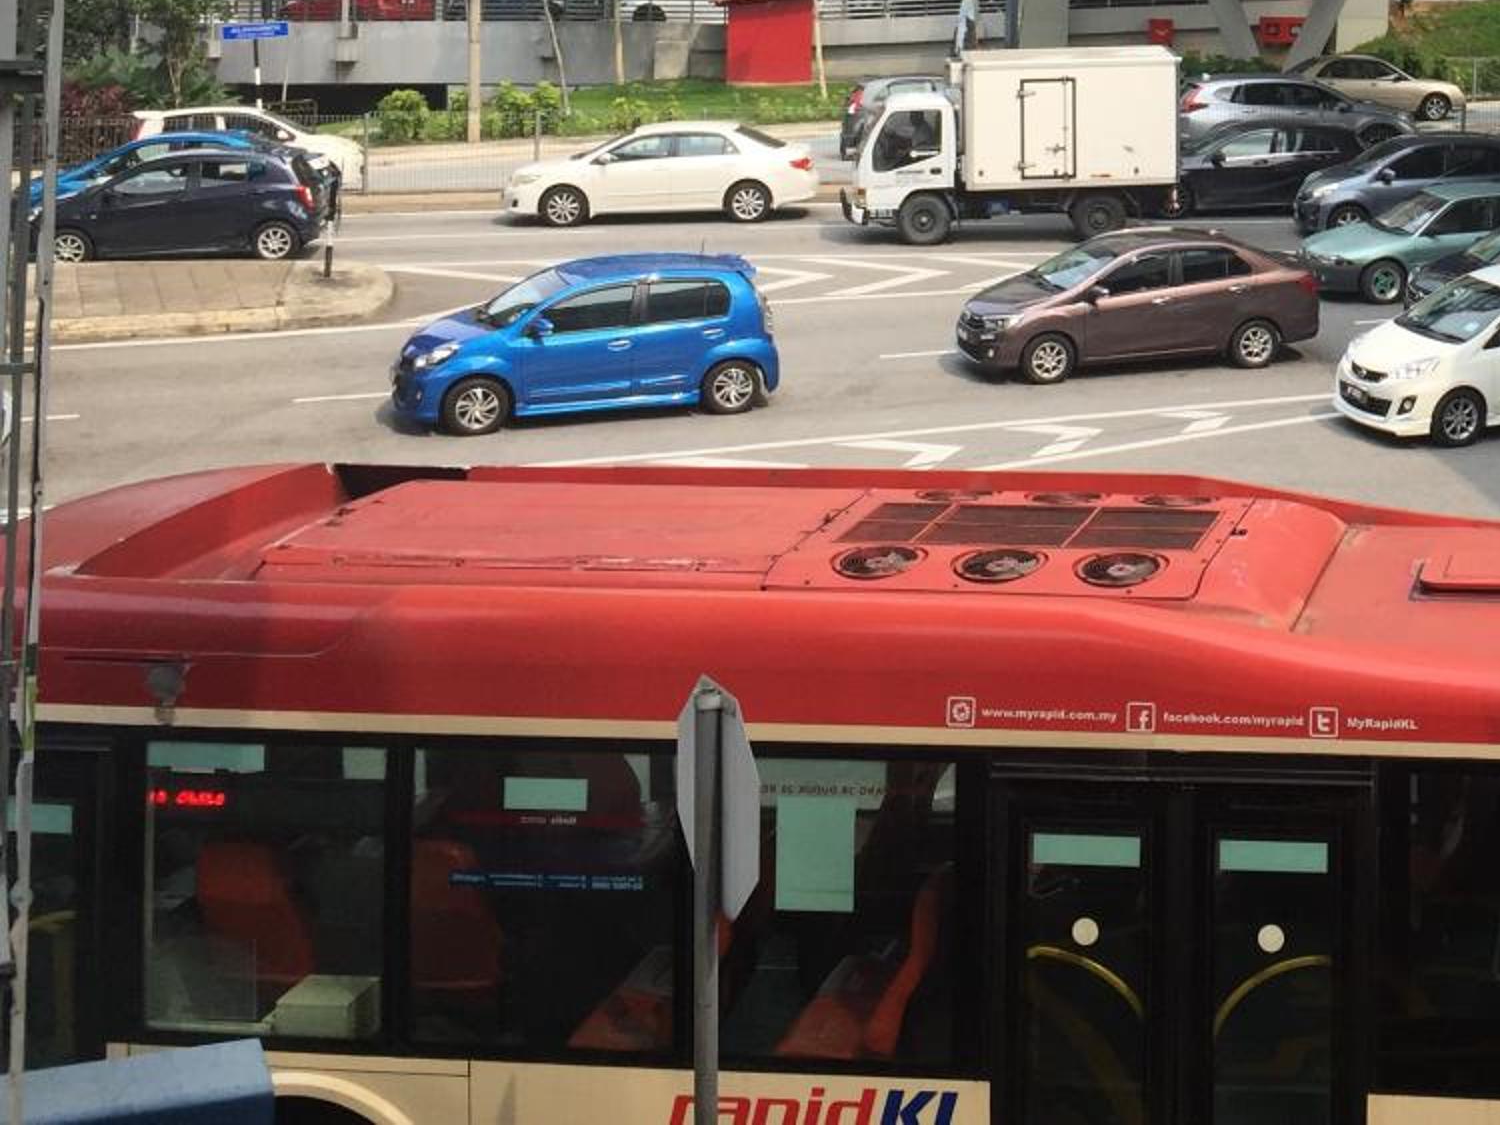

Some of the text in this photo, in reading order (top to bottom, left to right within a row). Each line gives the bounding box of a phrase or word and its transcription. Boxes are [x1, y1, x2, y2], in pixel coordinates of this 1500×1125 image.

[981, 708, 1118, 724] www.myrapid.com.my
[1163, 711, 1305, 728] facebook.com/myrapid
[1346, 716, 1419, 731] MyRapidKL
